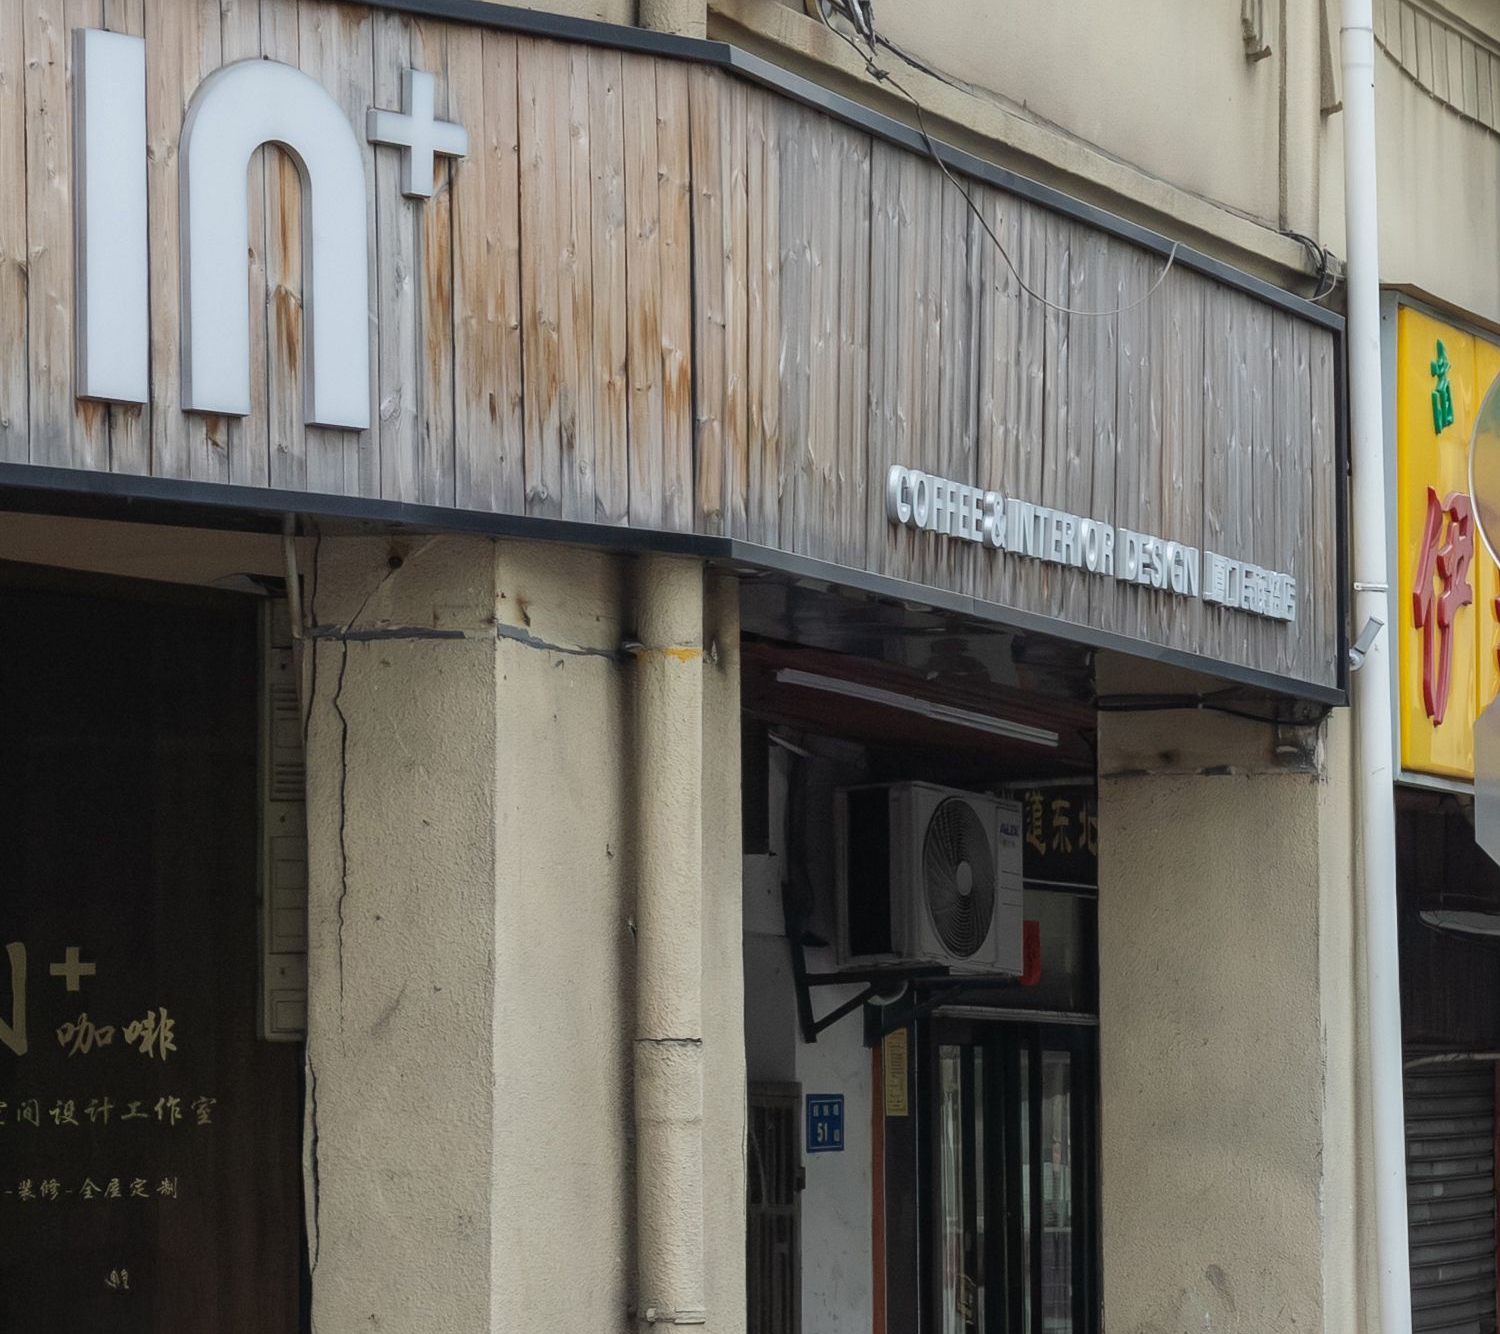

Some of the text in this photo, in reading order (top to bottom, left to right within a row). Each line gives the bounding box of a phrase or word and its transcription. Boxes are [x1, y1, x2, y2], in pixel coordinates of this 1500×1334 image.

[1118, 527, 1199, 598] DESIGN
[55, 1006, 178, 1062] 咖啡
[817, 1122, 828, 1143] 51
